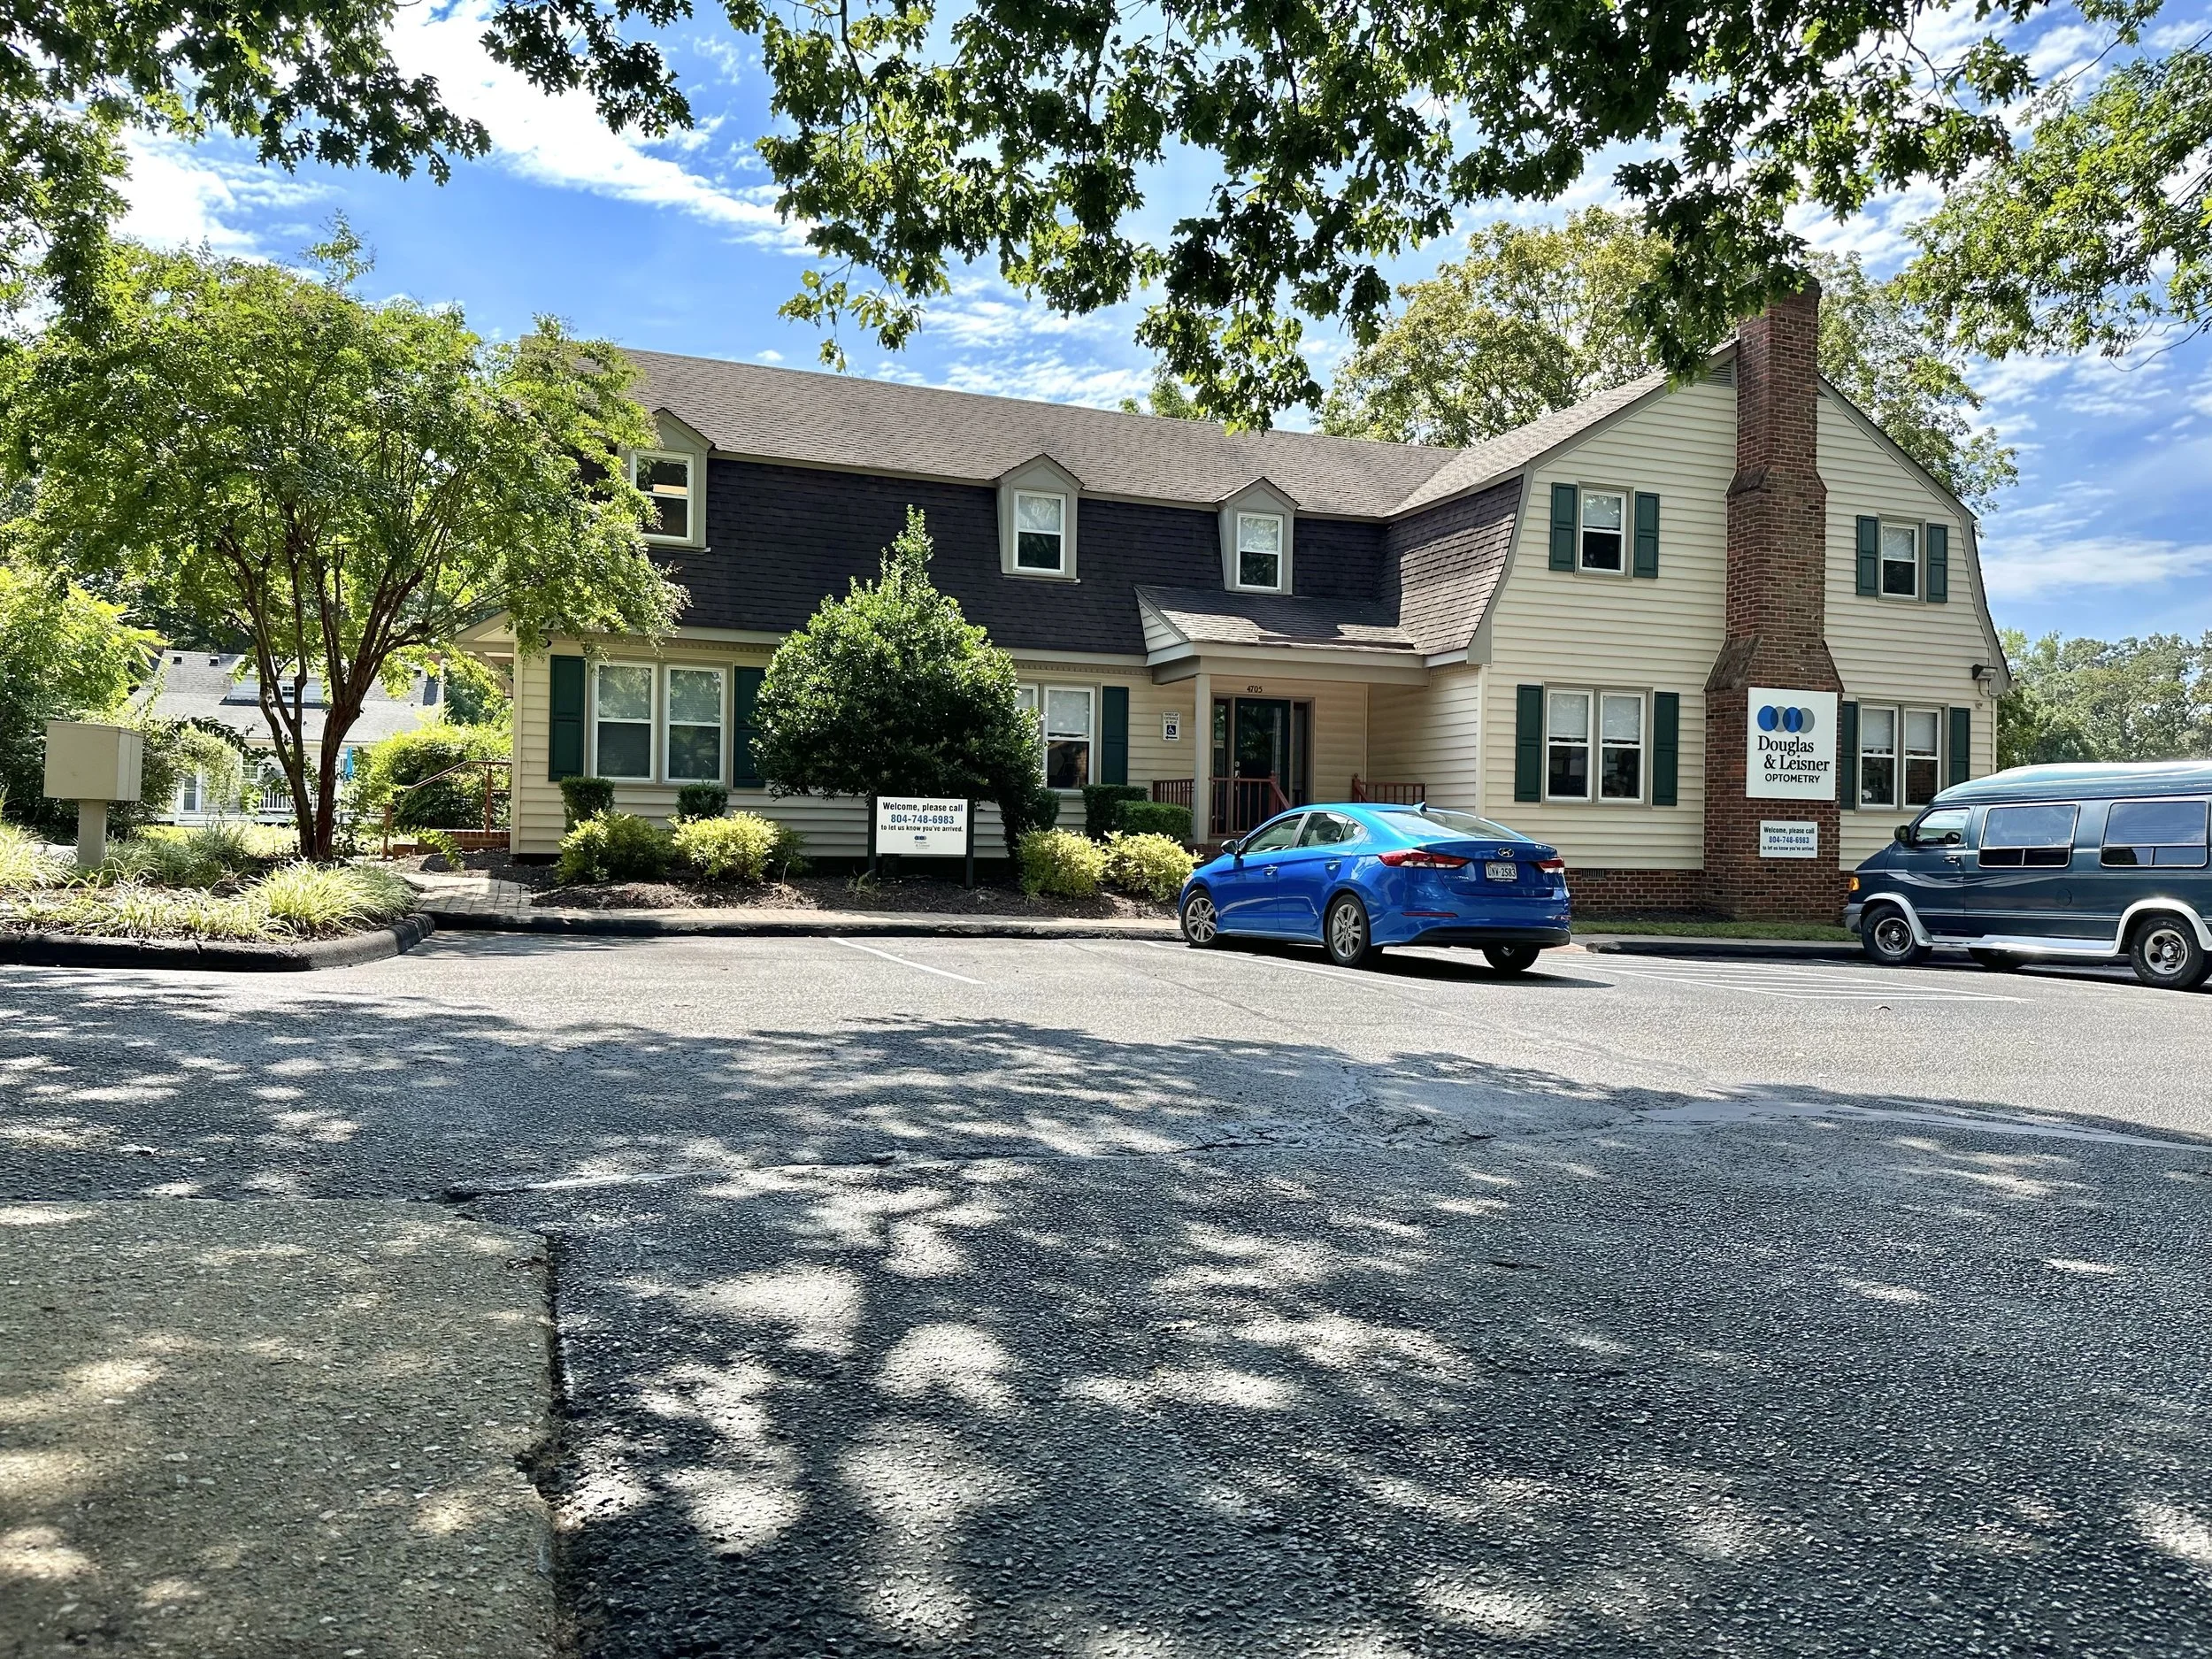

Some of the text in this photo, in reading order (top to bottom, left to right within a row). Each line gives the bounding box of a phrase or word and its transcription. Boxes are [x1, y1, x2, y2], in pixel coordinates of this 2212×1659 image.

[1757, 735, 1815, 756] Douglas
[1763, 754, 1830, 772] & Leisner
[1764, 773, 1820, 783] OPTOMETRY
[883, 802, 920, 811] Welcome,
[922, 803, 947, 812] please
[890, 814, 955, 824] 804-748-6983
